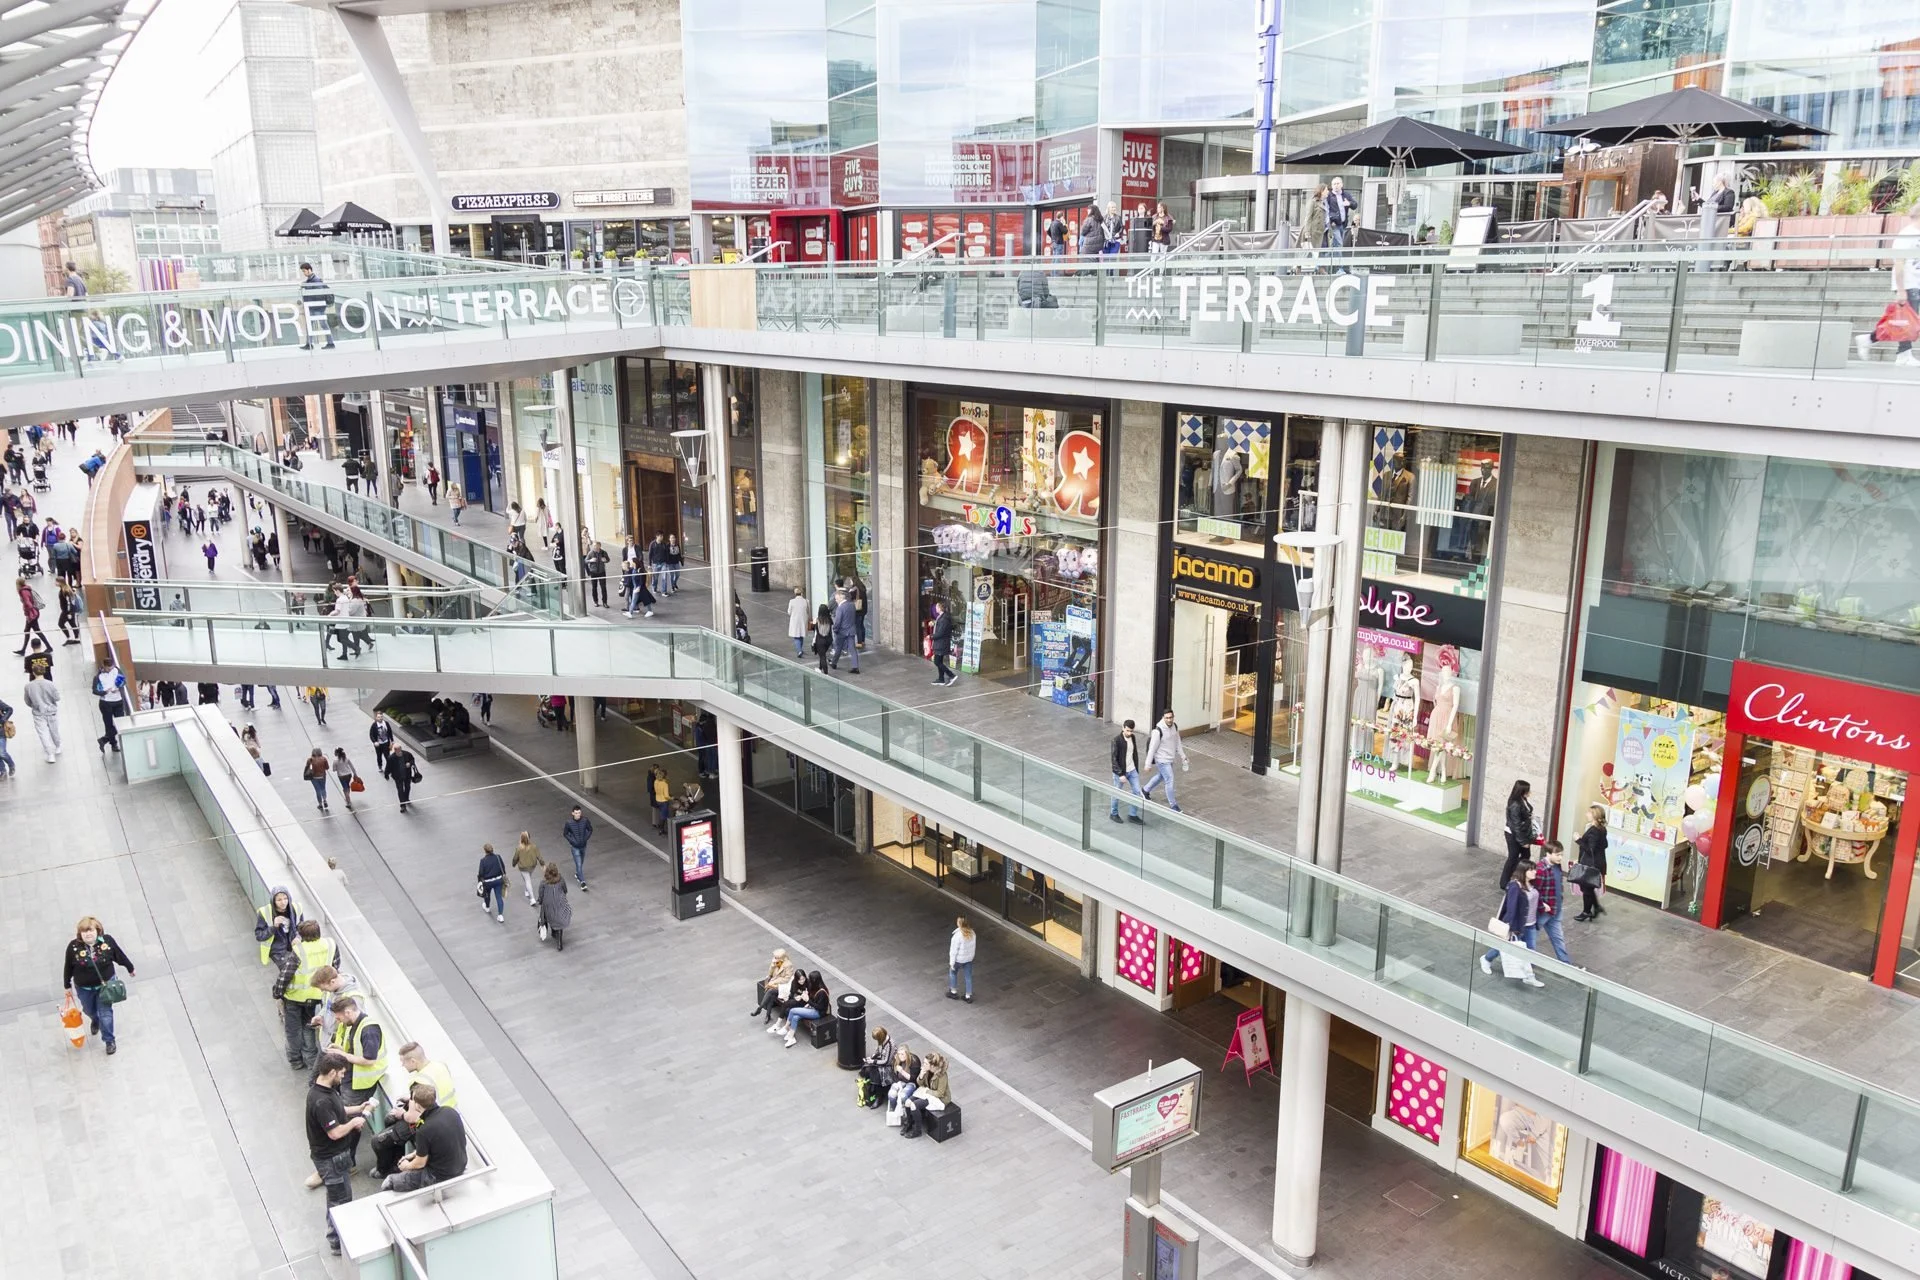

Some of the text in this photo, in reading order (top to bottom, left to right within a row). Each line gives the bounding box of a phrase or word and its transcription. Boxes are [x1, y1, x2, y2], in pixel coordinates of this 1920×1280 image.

[1123, 141, 1152, 160] FIVE
[845, 159, 861, 176] FIVE
[1050, 154, 1080, 178] FRESH
[1121, 160, 1156, 179] GUYS
[733, 176, 786, 189] FREEZER
[843, 175, 863, 192] GUYS
[954, 173, 992, 186] HIRING
[458, 193, 549, 209] PIZZAEXPRESS
[762, 191, 788, 200] JOINT
[1125, 277, 1163, 298] THE
[403, 294, 439, 311] THE
[447, 283, 611, 324] TERRACE
[1171, 274, 1396, 327] TERRACE
[1576, 275, 1622, 337] 1
[0, 297, 401, 364] DINING & MORE ON
[1574, 346, 1592, 354] ONE
[1575, 338, 1618, 349] LIVERPOOL
[581, 378, 613, 396] Express
[1172, 549, 1254, 589] jacamo
[1178, 589, 1249, 612] www.jacamo.co.uk
[1744, 683, 1911, 750] Clintons
[1365, 751, 1388, 767] DAY
[824, 1030, 832, 1041] 1
[946, 1121, 954, 1133] 1
